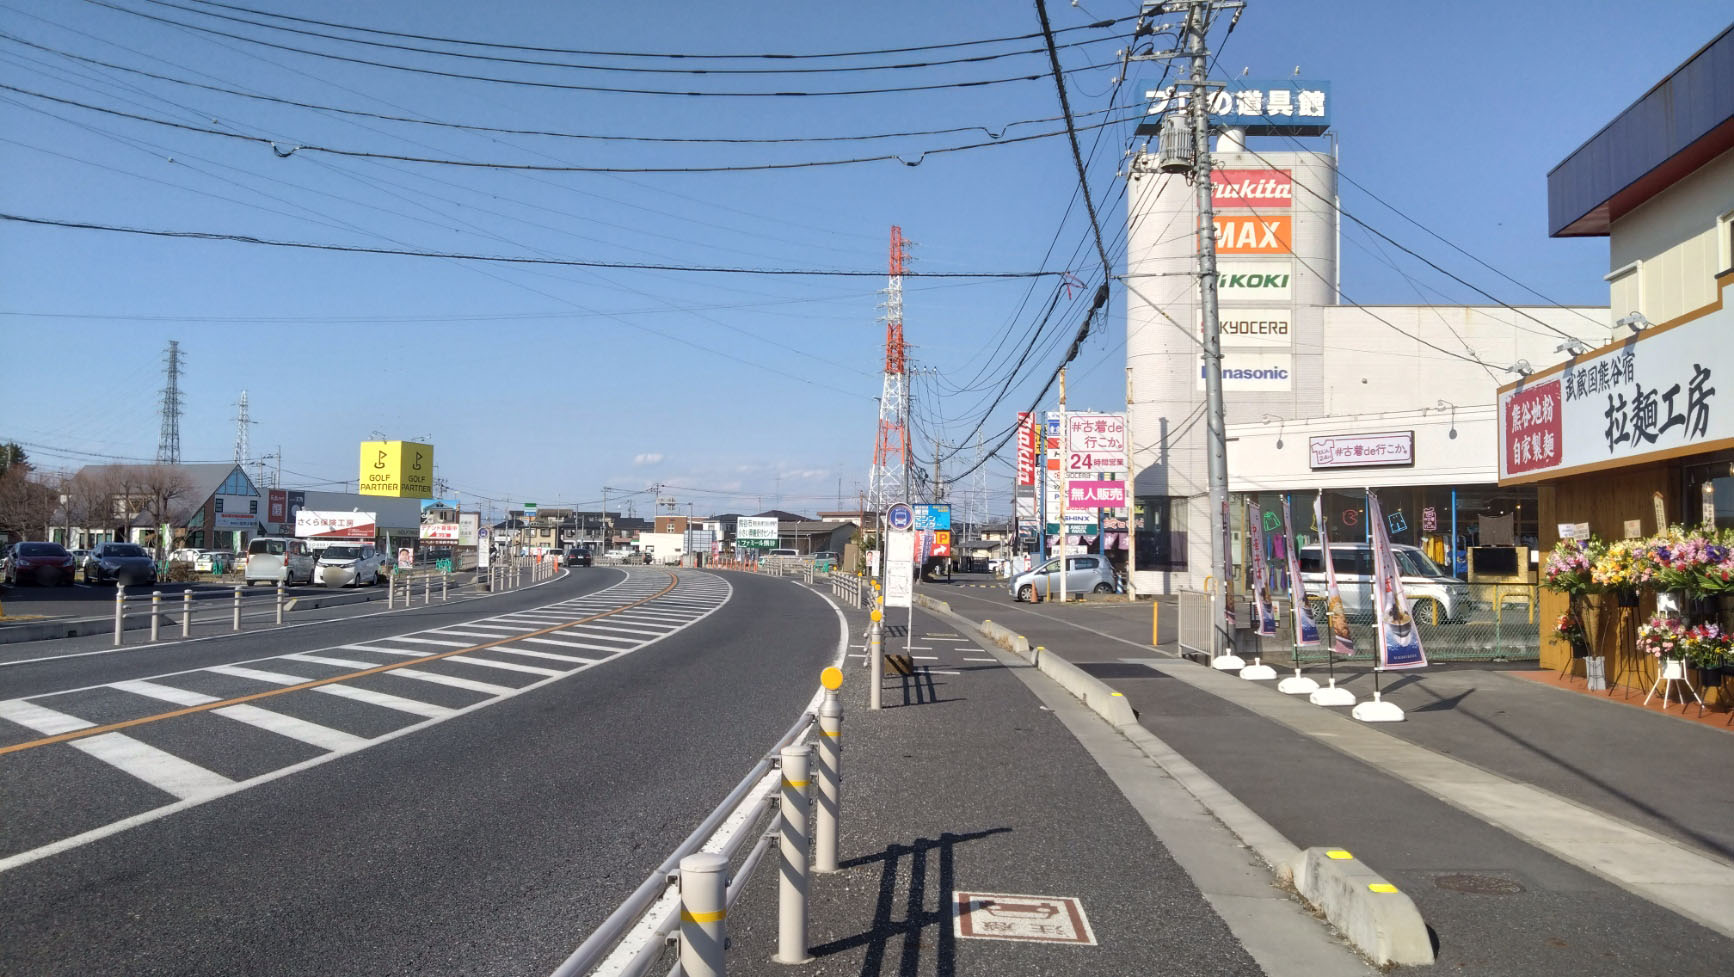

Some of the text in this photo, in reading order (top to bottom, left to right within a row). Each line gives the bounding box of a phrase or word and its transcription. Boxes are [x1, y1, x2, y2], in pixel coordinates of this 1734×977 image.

[1212, 179, 1292, 199] akita
[1213, 221, 1280, 249] MAX
[1203, 274, 1290, 288] iKOKI
[1201, 365, 1289, 379] nasonic
[1565, 352, 1635, 403] 武蔵国熊谷宿
[1511, 394, 1555, 434] 熊谷地粉
[1084, 437, 1123, 449] 行こか。
[369, 474, 391, 482] GOLF
[408, 475, 426, 483] GOLF
[360, 483, 399, 491] PARTNER
[401, 484, 431, 493] PARTNER
[1071, 488, 1123, 501] 無人販売
[297, 518, 354, 527] さくら保険工房
[939, 533, 948, 542] P
